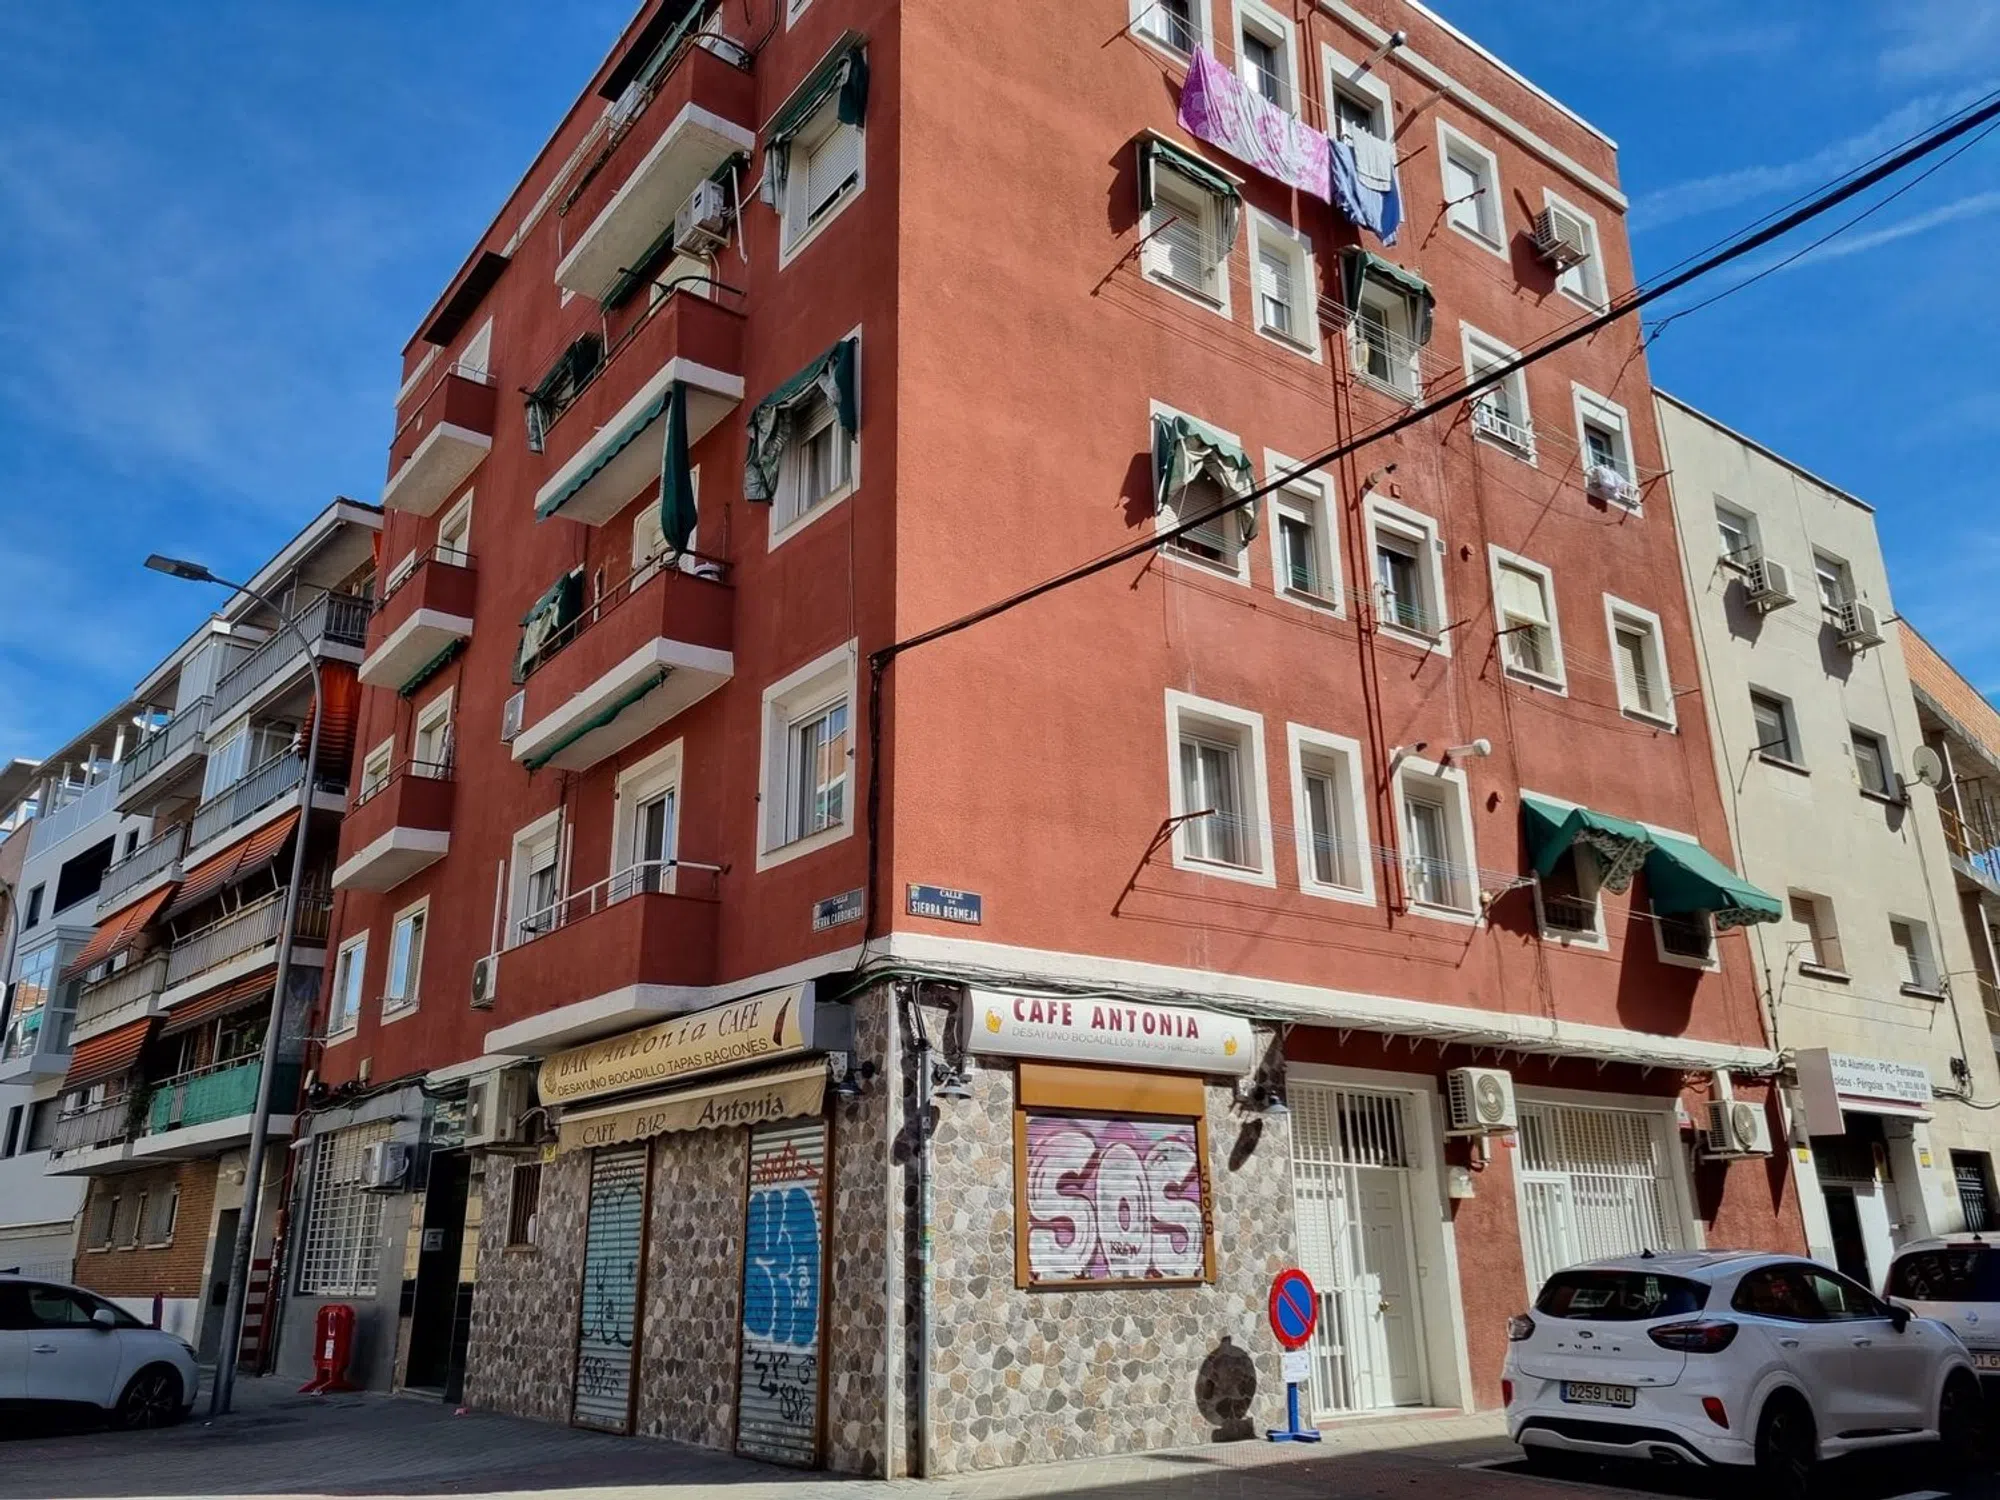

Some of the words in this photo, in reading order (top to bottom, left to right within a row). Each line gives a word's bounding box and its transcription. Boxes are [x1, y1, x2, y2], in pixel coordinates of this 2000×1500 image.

[940, 889, 964, 900] CALLE
[912, 901, 941, 916] SIERRA
[943, 905, 979, 921] BERMEJA
[1012, 1026, 1070, 1041] DESAYUNO
[1013, 998, 1072, 1026] CAFE
[1091, 1006, 1199, 1039] ANTONIA
[560, 1048, 591, 1077] BAR
[598, 1021, 707, 1065] Antonia
[558, 1077, 606, 1096] DESAYUNO
[609, 1064, 666, 1085] BOCADILLO
[667, 1054, 702, 1072] TAPAS
[704, 1038, 768, 1060] RACIONES
[582, 1117, 617, 1145] CAFÉ
[636, 1113, 667, 1136] BAR
[697, 1093, 785, 1126] Antonia
[1569, 1384, 1601, 1400] 0259
[1605, 1387, 1631, 1403] LGL
